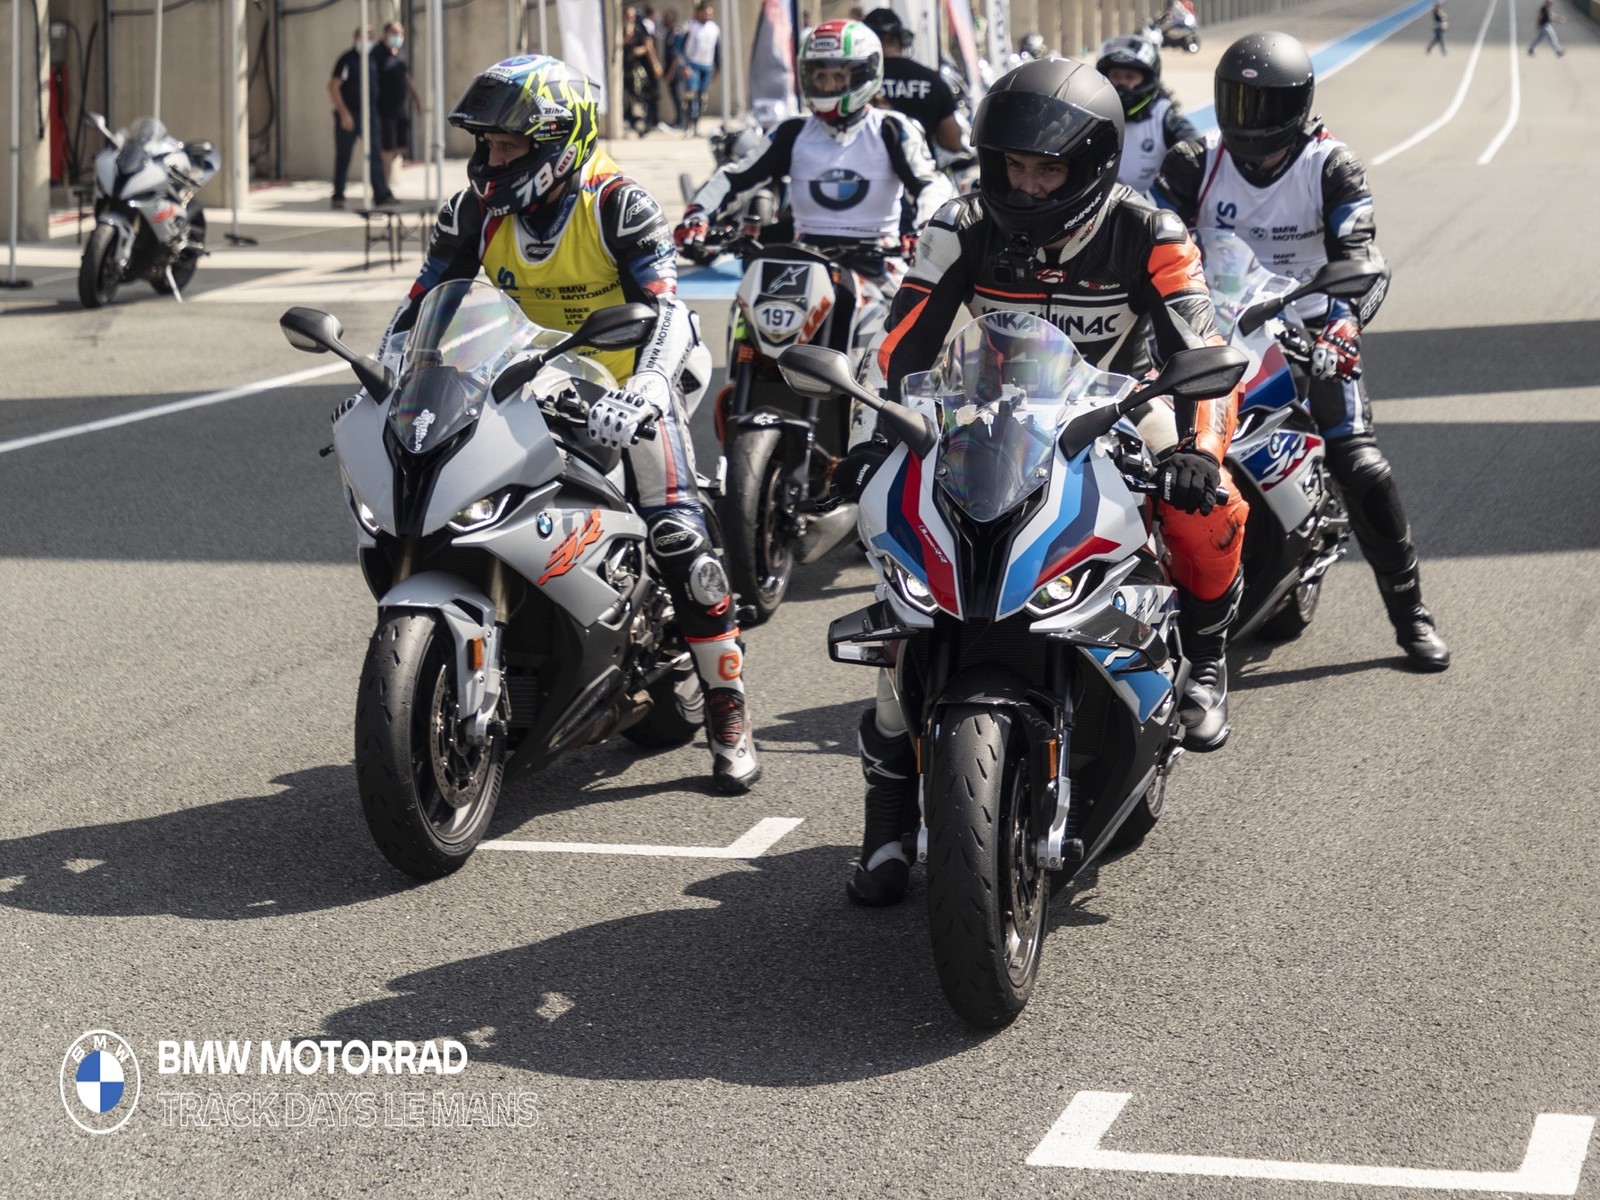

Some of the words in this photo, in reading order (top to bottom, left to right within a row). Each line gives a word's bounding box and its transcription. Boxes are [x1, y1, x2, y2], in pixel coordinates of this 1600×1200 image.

[557, 149, 576, 174] BELL
[515, 161, 555, 208] 78
[762, 307, 796, 328] 197
